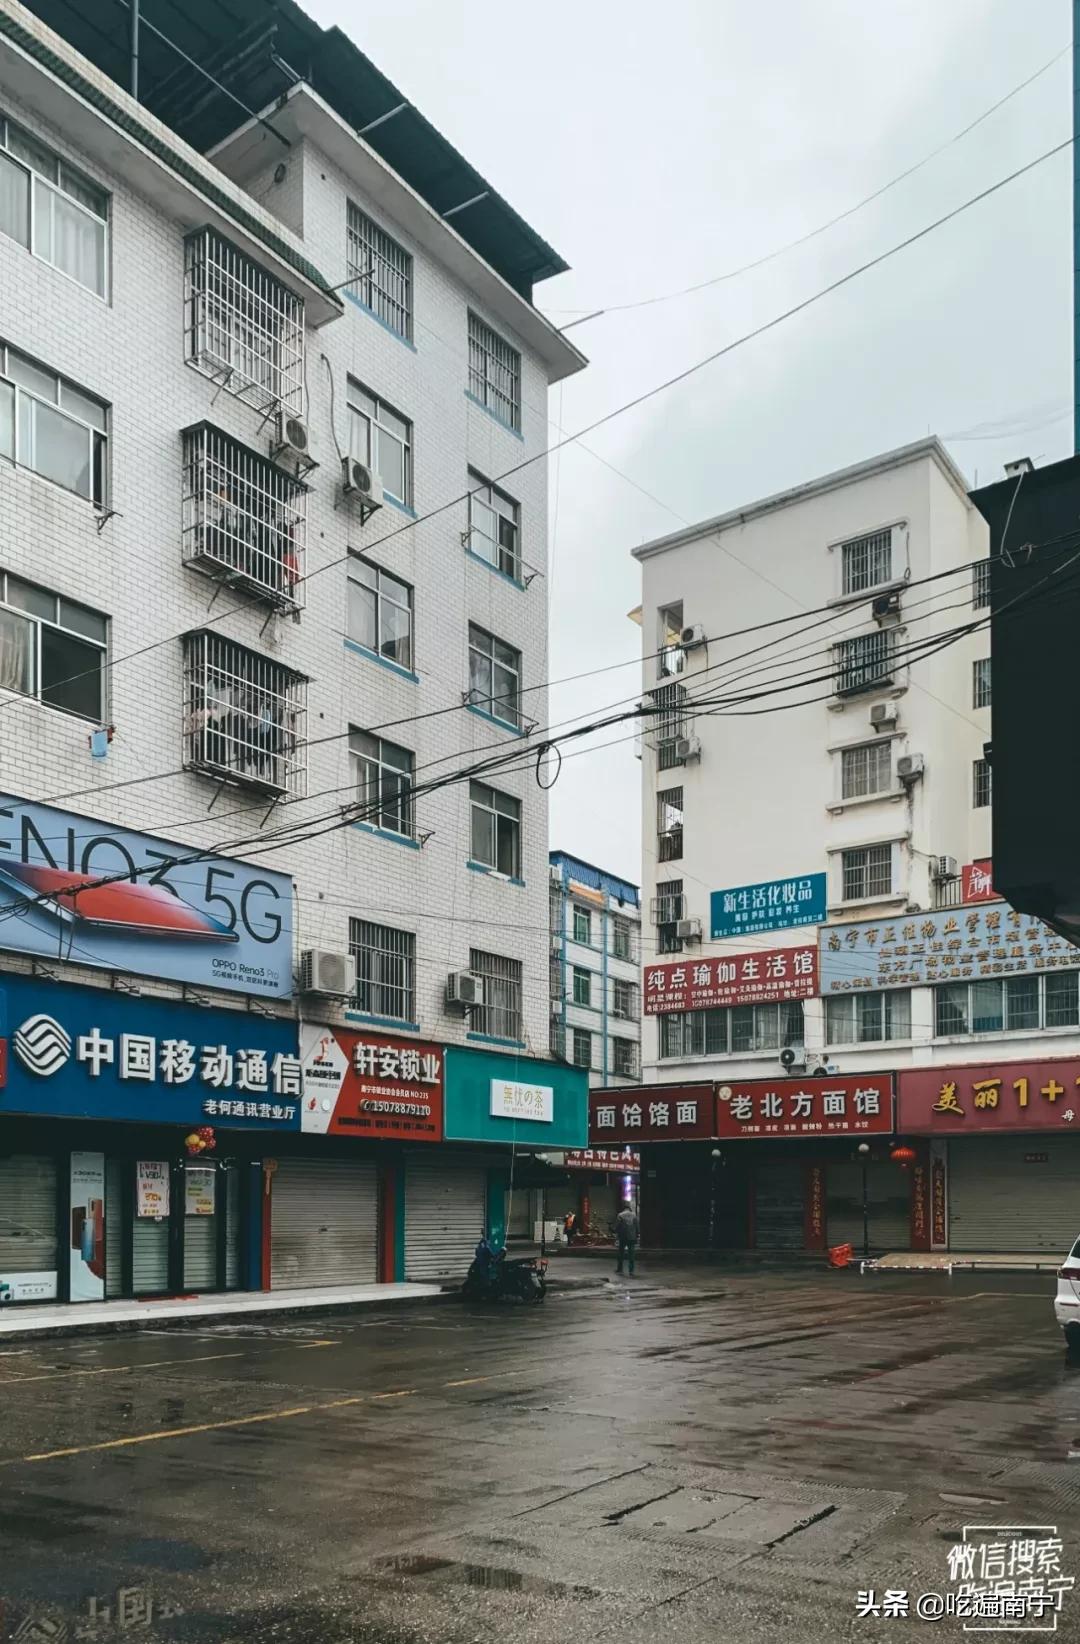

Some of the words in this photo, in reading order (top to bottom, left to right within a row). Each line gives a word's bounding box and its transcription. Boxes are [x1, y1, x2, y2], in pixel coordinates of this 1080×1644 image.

[204, 866, 282, 944] 5G
[723, 880, 813, 913] 新生活化妆品
[212, 958, 237, 971] OPPO
[239, 963, 265, 977] Reno3
[266, 968, 279, 980] Pro
[647, 950, 814, 990] 纯点瑜伽生活馆
[76, 1027, 303, 1096] 中国移动通信
[353, 1041, 441, 1084] 轩安锁业
[203, 1099, 297, 1120] 老何通讯营业厅
[588, 1100, 698, 1129] 面饸饹面
[729, 1087, 881, 1120] 老北方面馆
